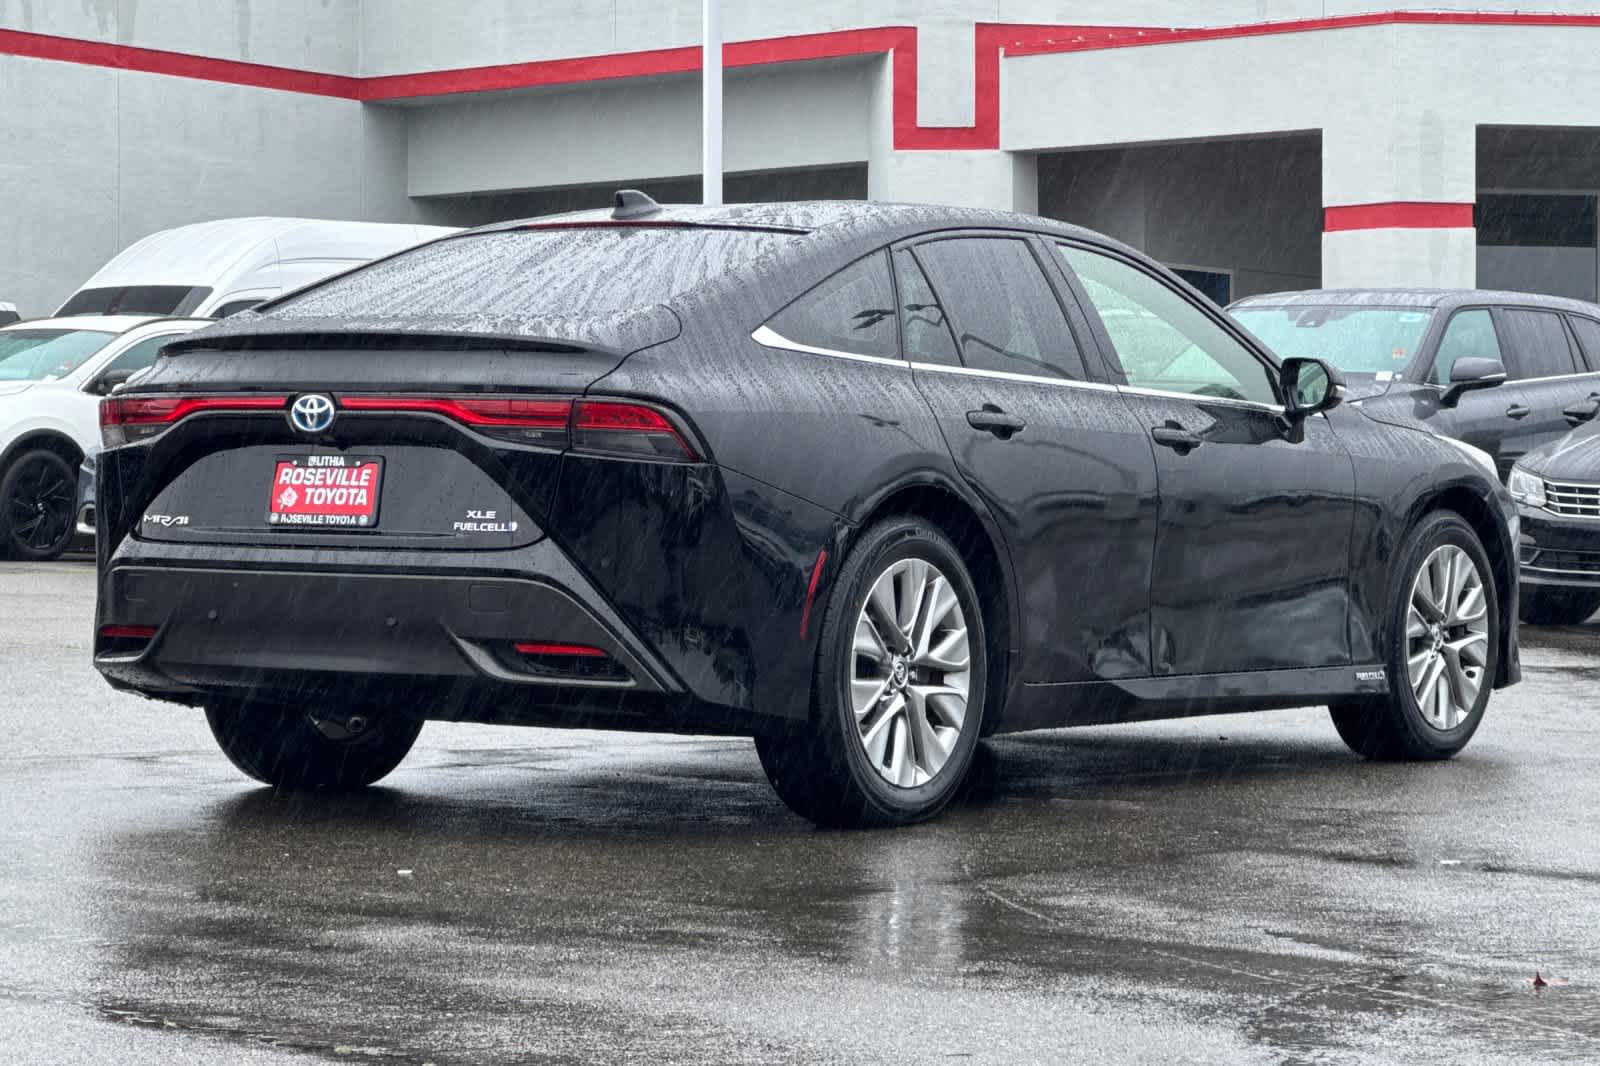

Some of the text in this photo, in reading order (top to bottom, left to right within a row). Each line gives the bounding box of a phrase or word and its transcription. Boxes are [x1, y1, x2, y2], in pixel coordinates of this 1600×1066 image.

[316, 456, 345, 467] LITHIA
[279, 468, 371, 486] ROSEVILLE
[305, 488, 368, 505] TOYOTA
[280, 514, 356, 525] ROSEVILLE TOYOTA
[466, 510, 497, 519] XLE
